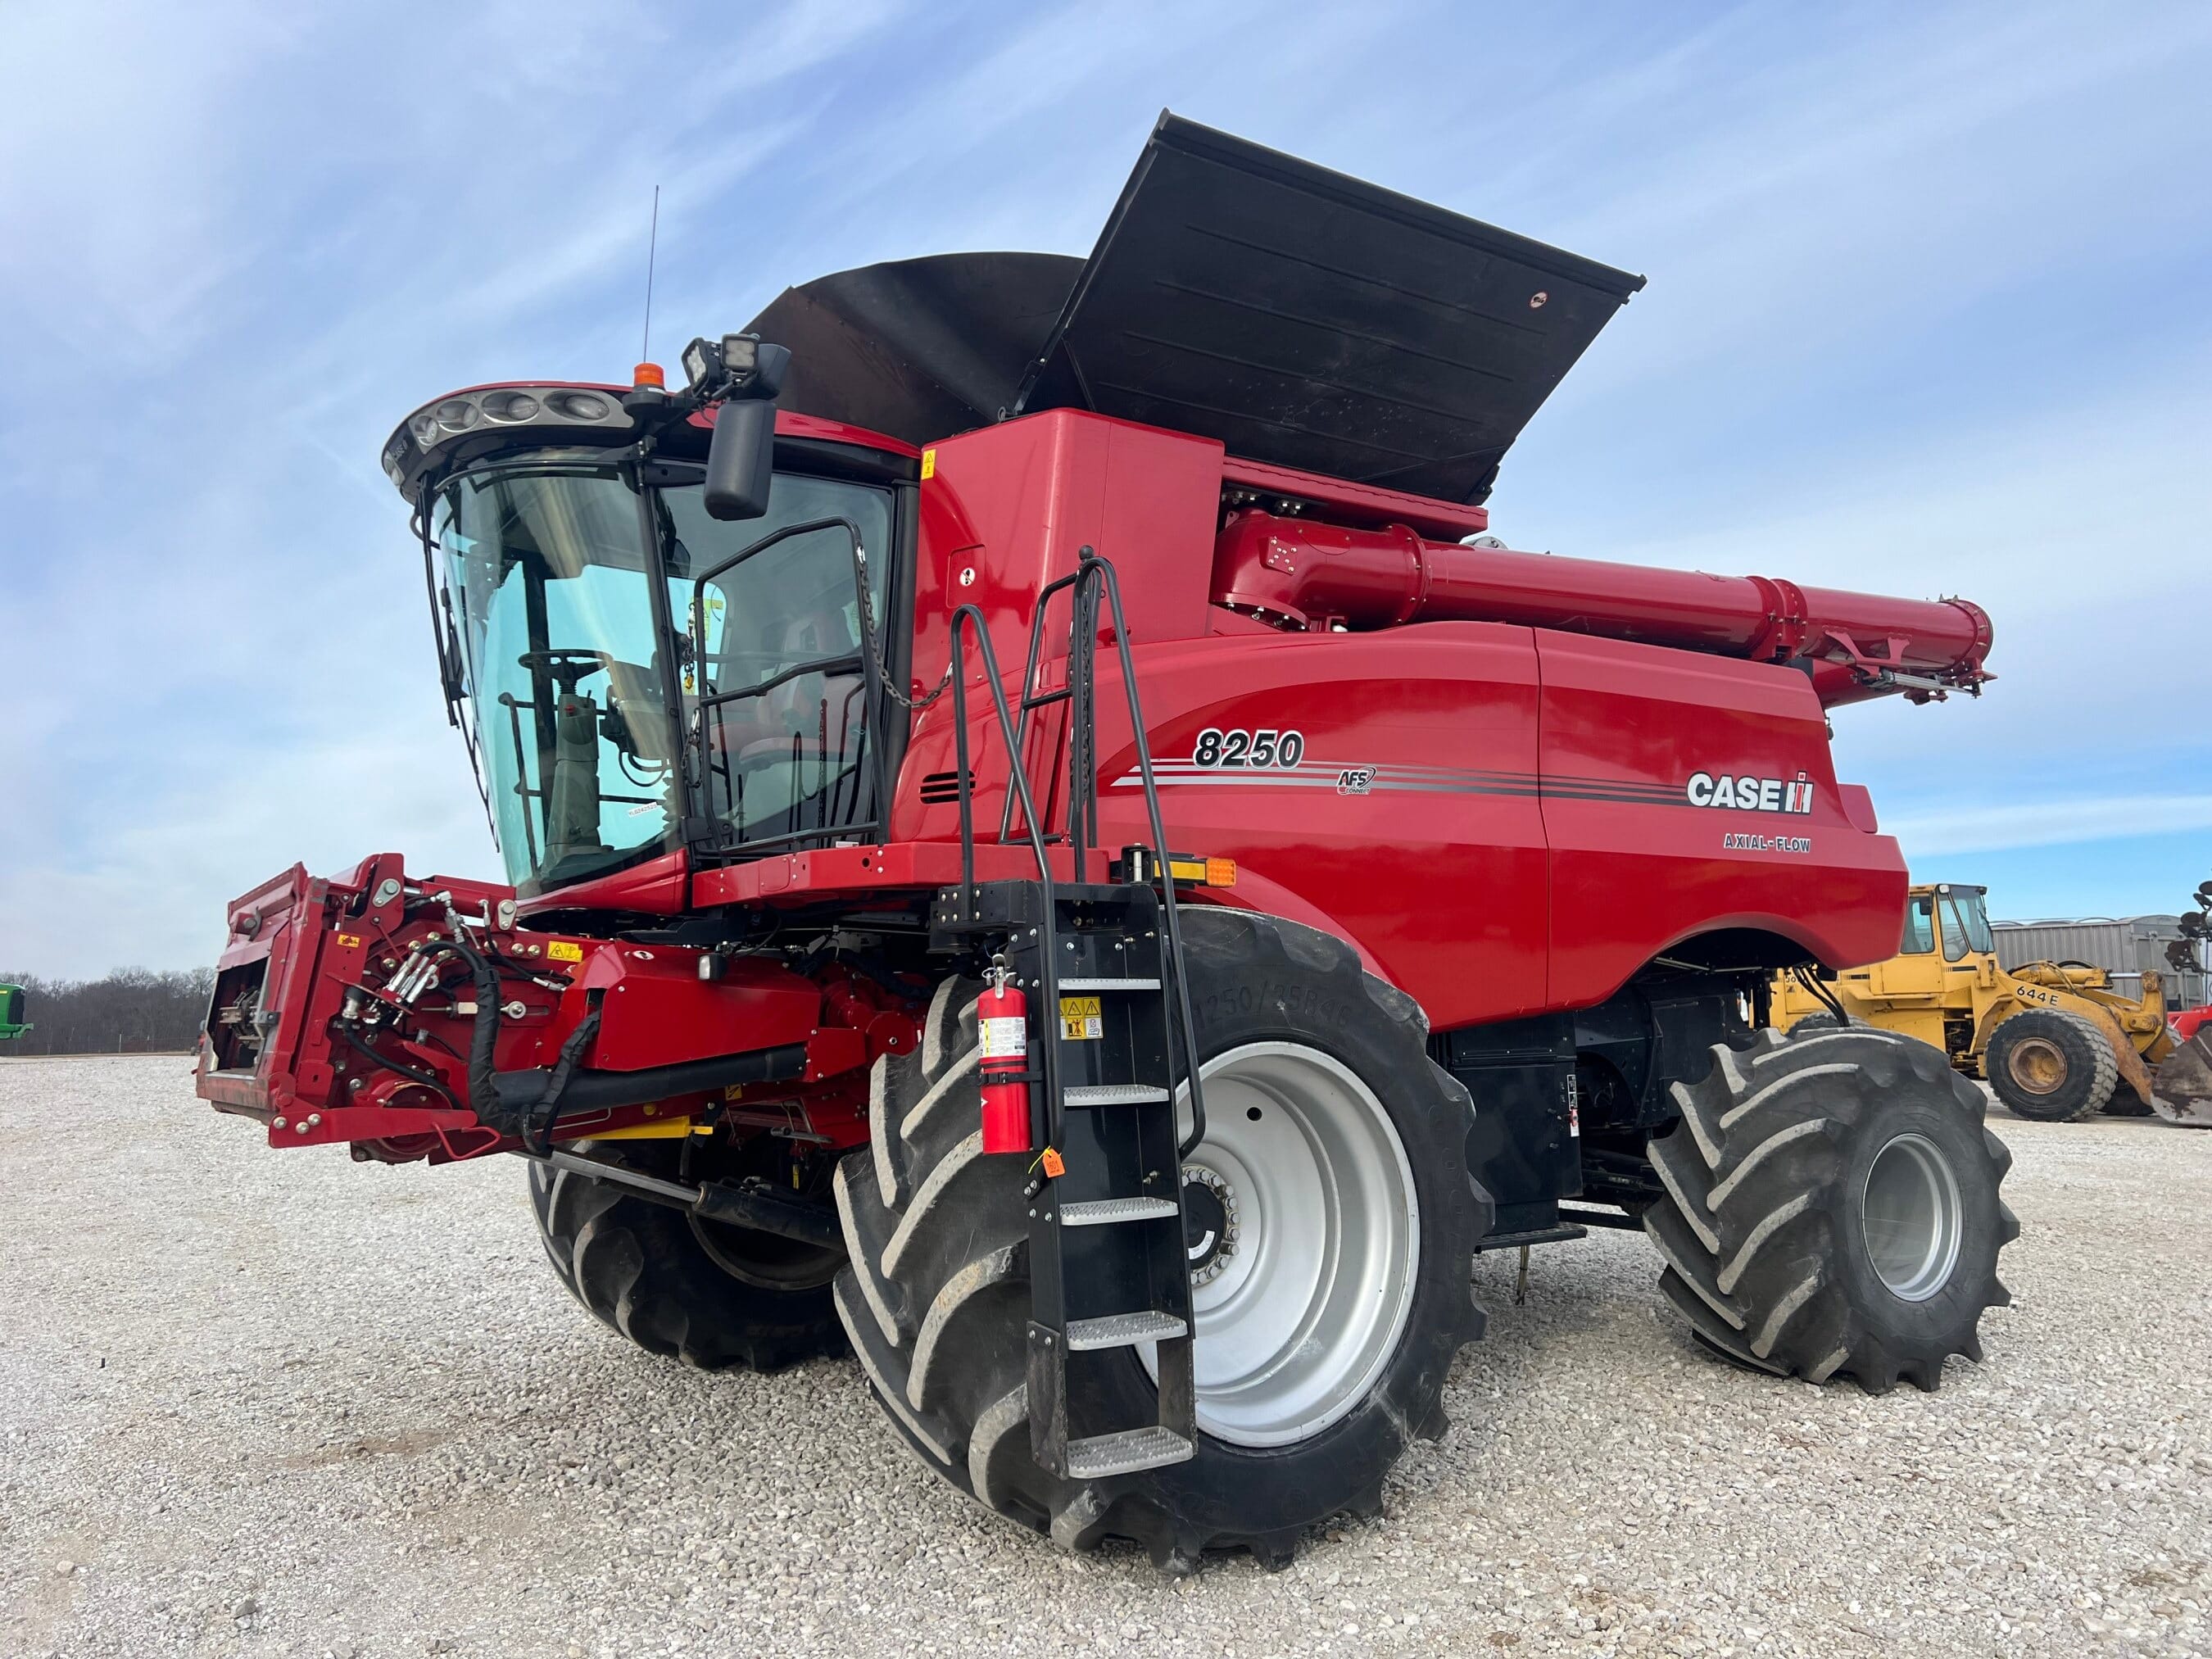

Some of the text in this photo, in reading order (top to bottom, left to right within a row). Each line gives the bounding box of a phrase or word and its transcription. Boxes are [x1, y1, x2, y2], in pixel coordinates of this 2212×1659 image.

[1193, 728, 1303, 769] 8250
[1337, 769, 1368, 786] AFS
[1687, 772, 1782, 811] CASE
[1724, 832, 1811, 852] AXIAL-FLOW
